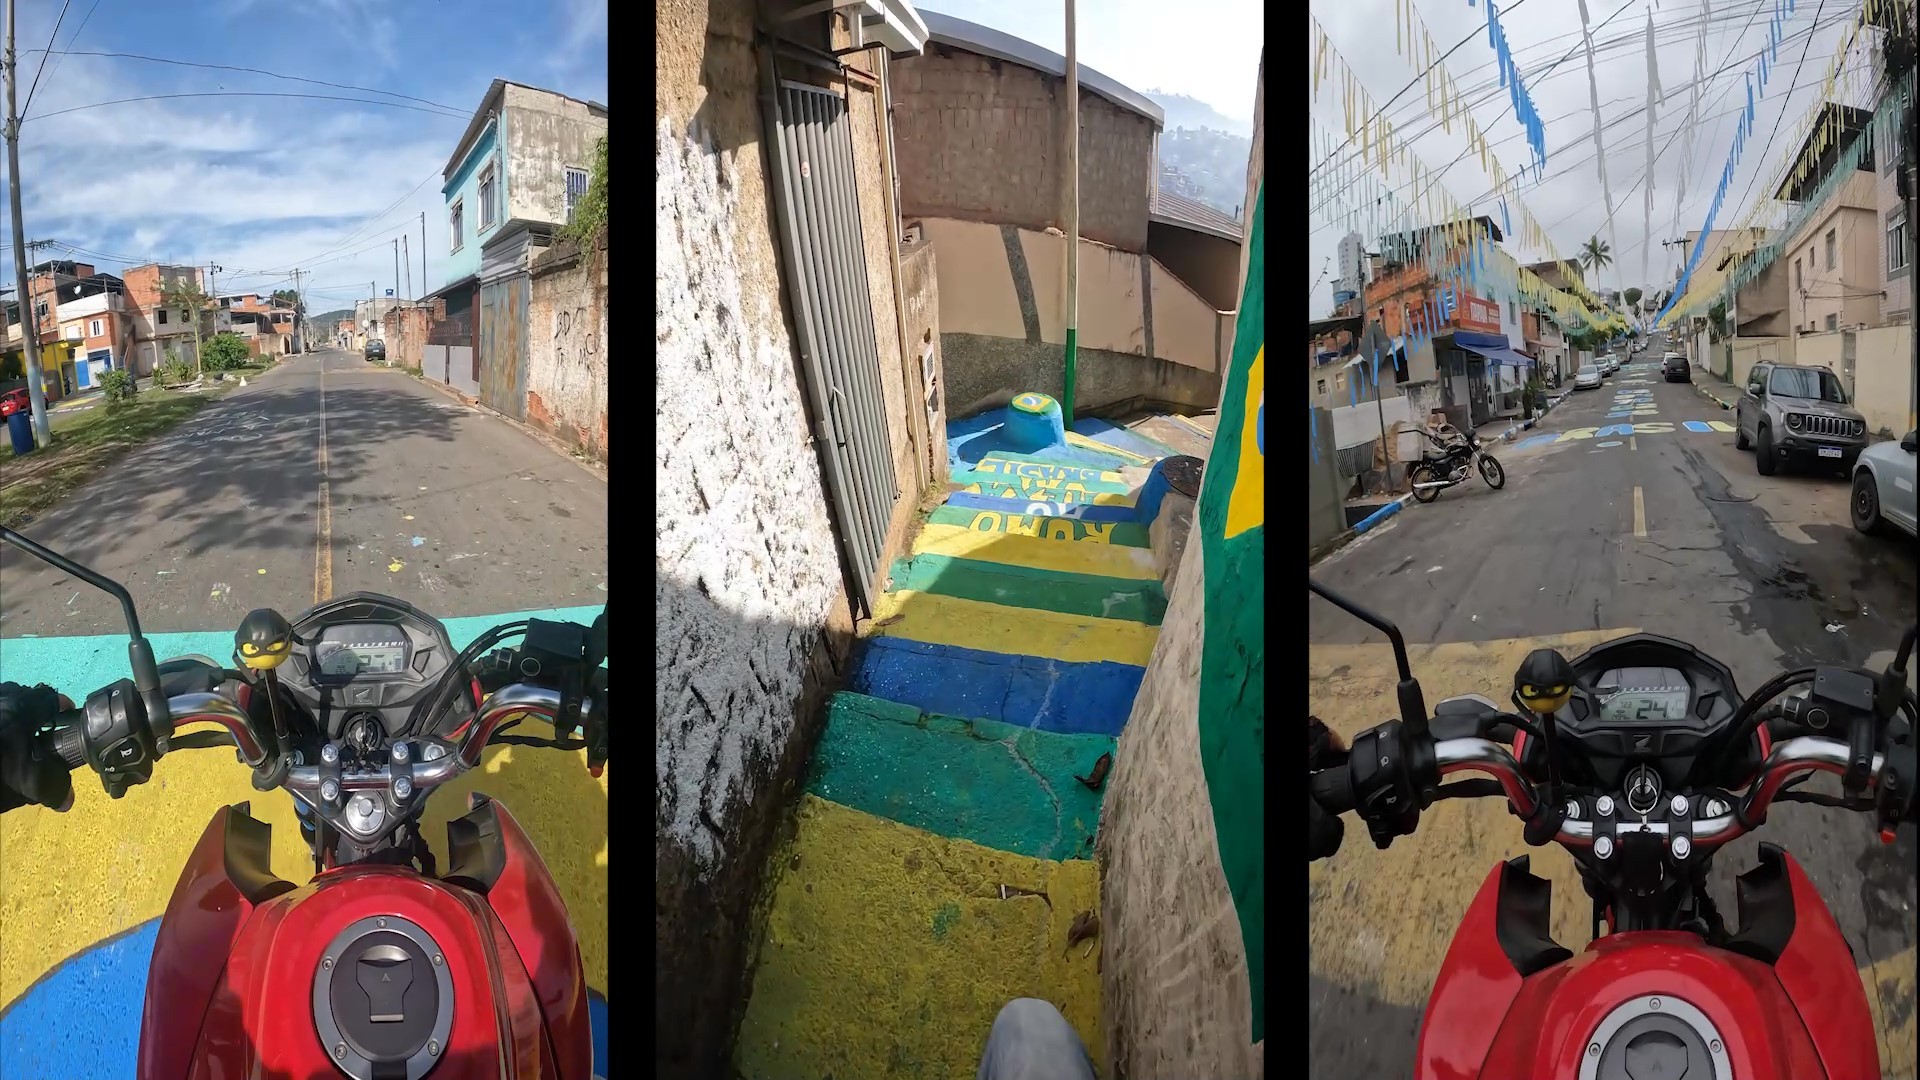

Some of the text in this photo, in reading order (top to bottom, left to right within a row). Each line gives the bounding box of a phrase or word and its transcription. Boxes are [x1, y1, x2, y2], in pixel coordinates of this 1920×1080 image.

[983, 459, 1102, 480] BRASIL
[979, 481, 1098, 504] HEXA
[969, 511, 1118, 544] RUMO
[1636, 699, 1669, 720] 24
